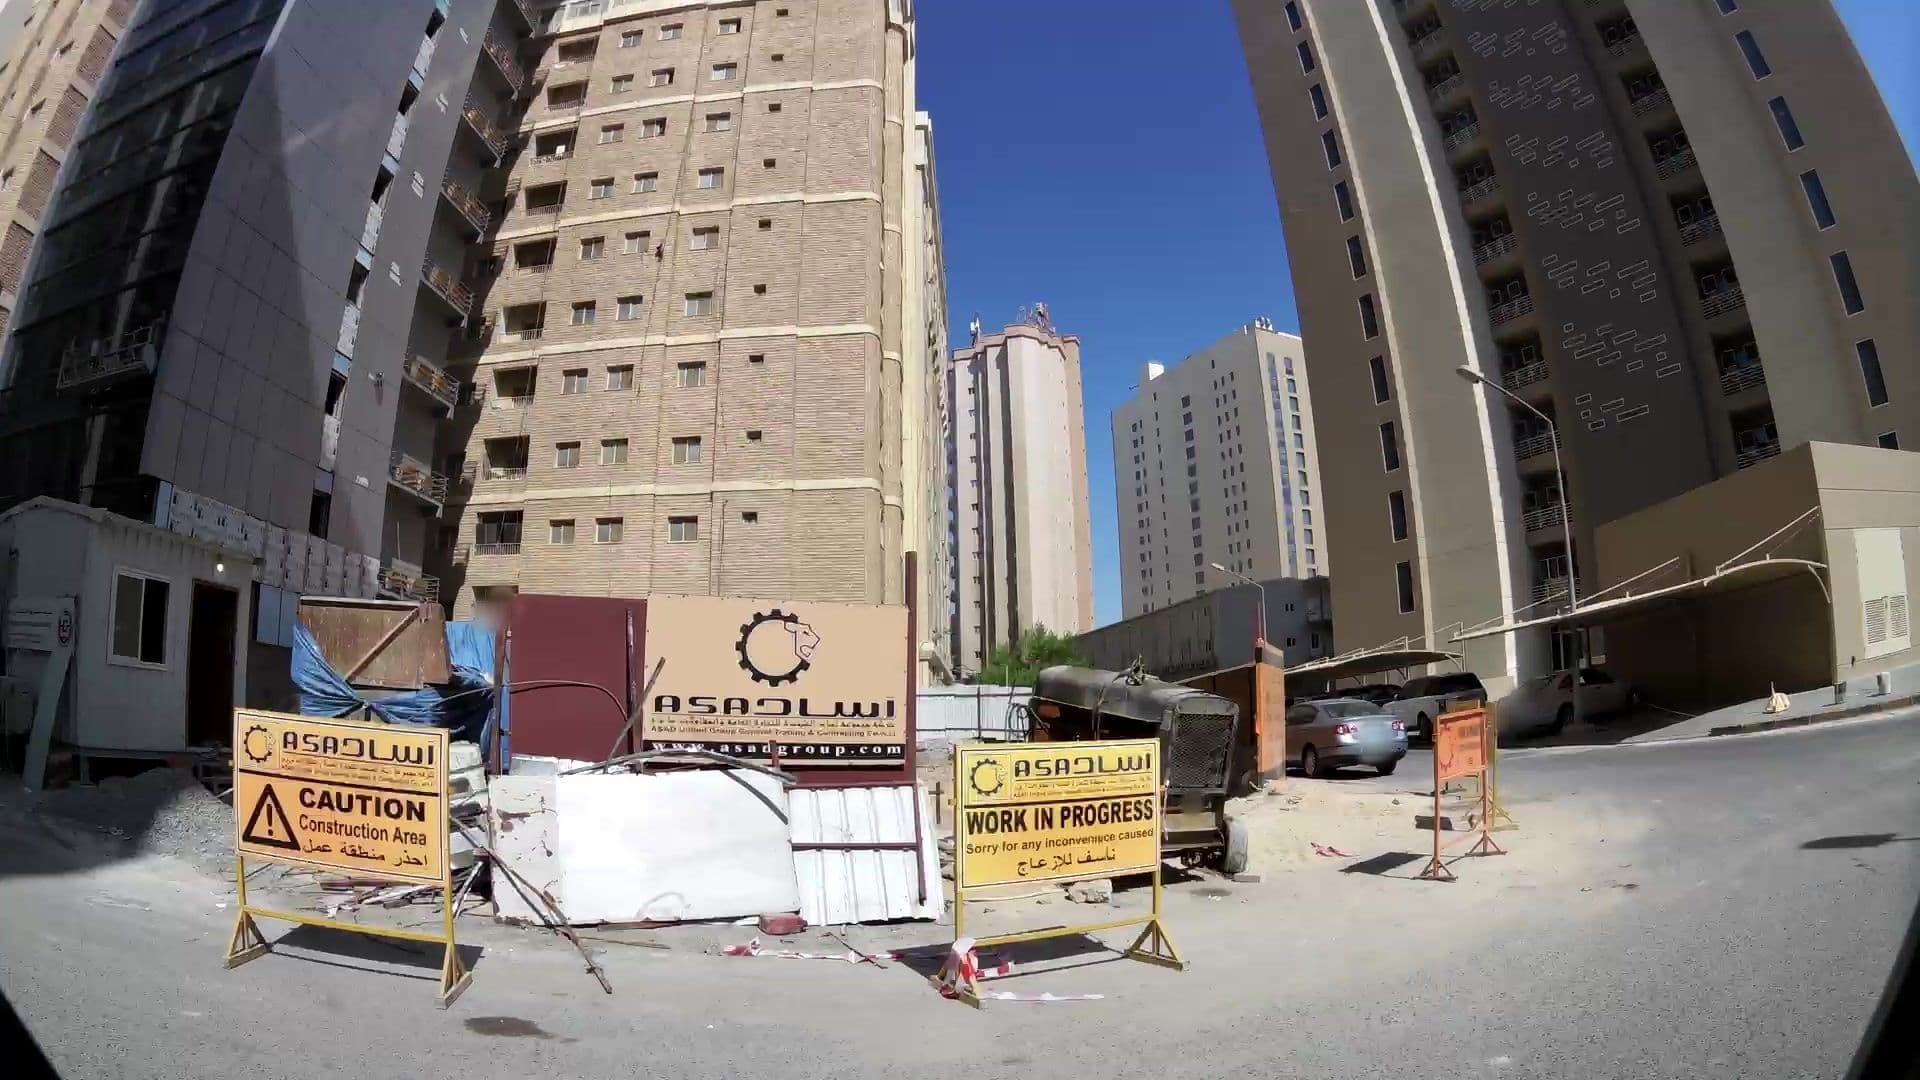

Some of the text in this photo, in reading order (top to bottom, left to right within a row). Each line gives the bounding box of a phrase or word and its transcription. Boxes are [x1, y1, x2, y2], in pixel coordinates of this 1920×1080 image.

[299, 787, 425, 822] CAUTION
[966, 799, 1153, 835] WORK IN PROGRESS
[299, 813, 427, 846] Construction Area
[966, 843, 998, 855] Sorry
[1002, 841, 1018, 852] for
[1021, 840, 1041, 852] any
[1118, 827, 1153, 841] caused
[340, 841, 386, 861] منطقة
